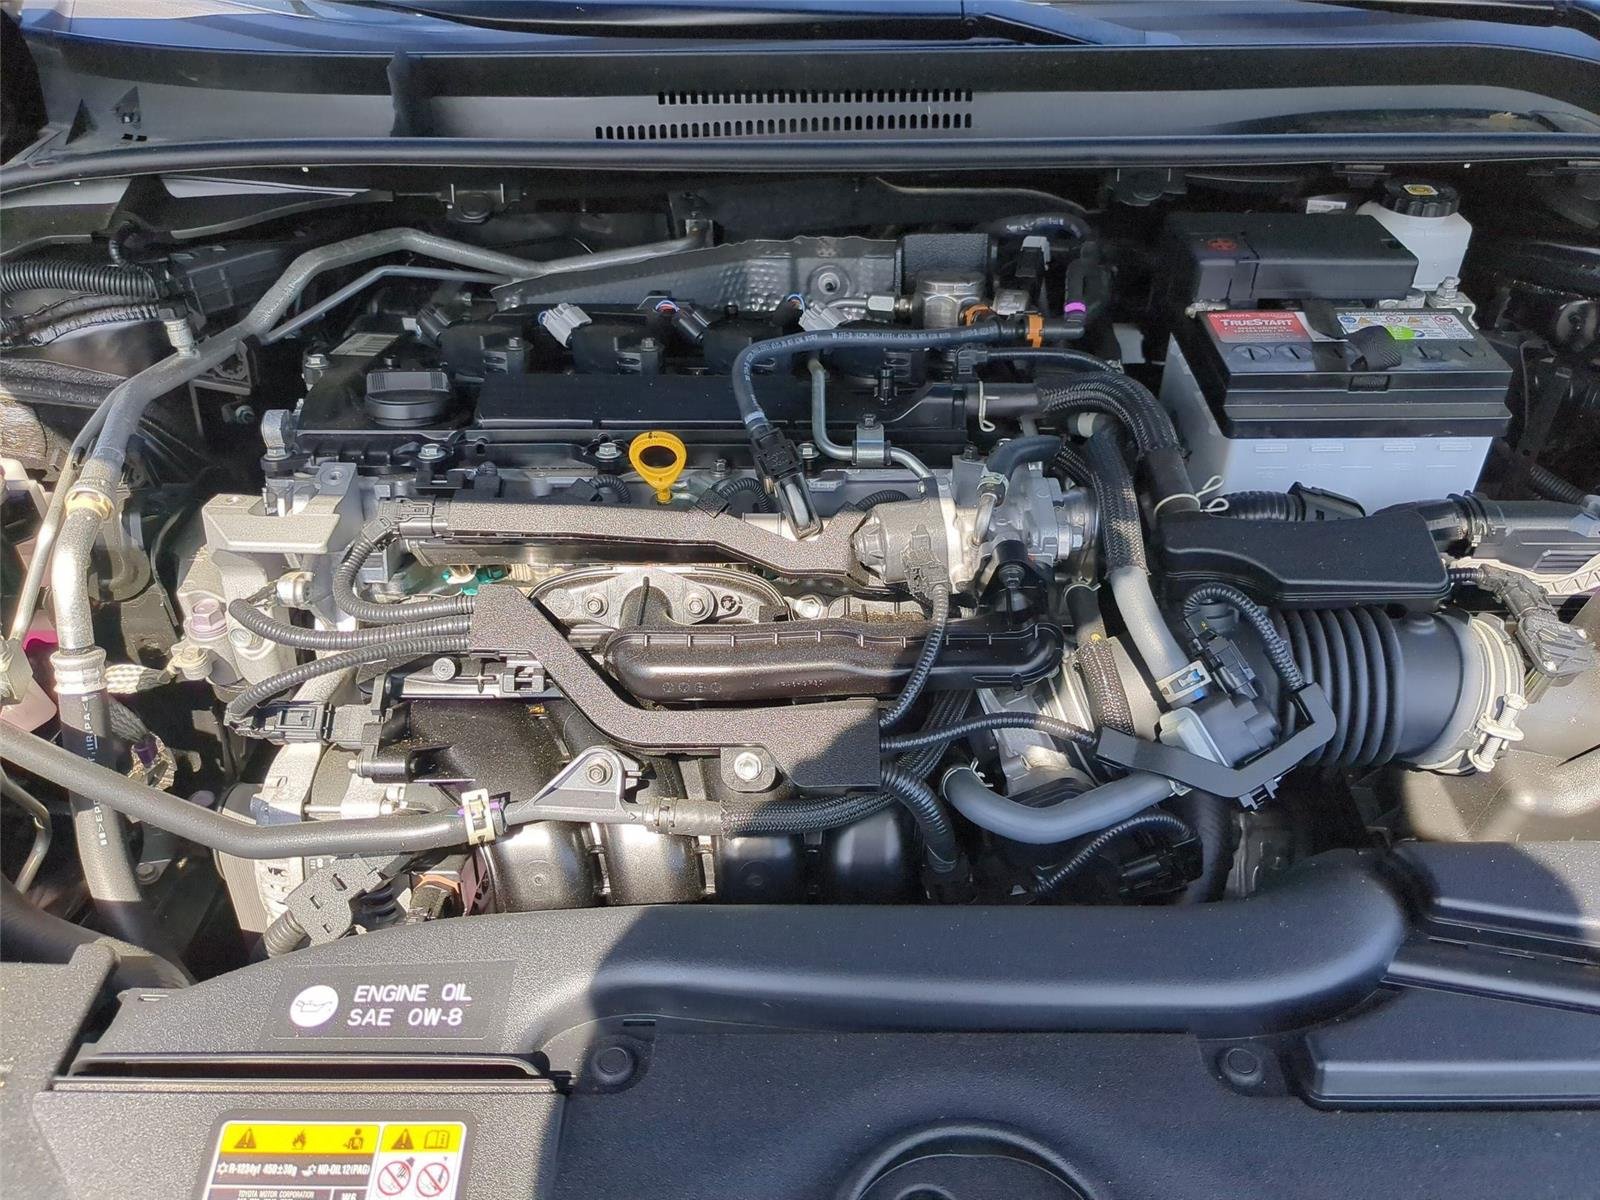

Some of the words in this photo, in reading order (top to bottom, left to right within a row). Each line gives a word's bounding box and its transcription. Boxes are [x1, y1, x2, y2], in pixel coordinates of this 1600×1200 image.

[353, 984, 430, 1003] ENGINE
[441, 983, 472, 1001] OIL
[347, 1008, 395, 1026] SAE
[408, 1007, 464, 1026] 0W-8
[239, 1189, 258, 1198] TOYOTA
[259, 1190, 278, 1198] MOTOR
[279, 1190, 315, 1199] CORPORATION
